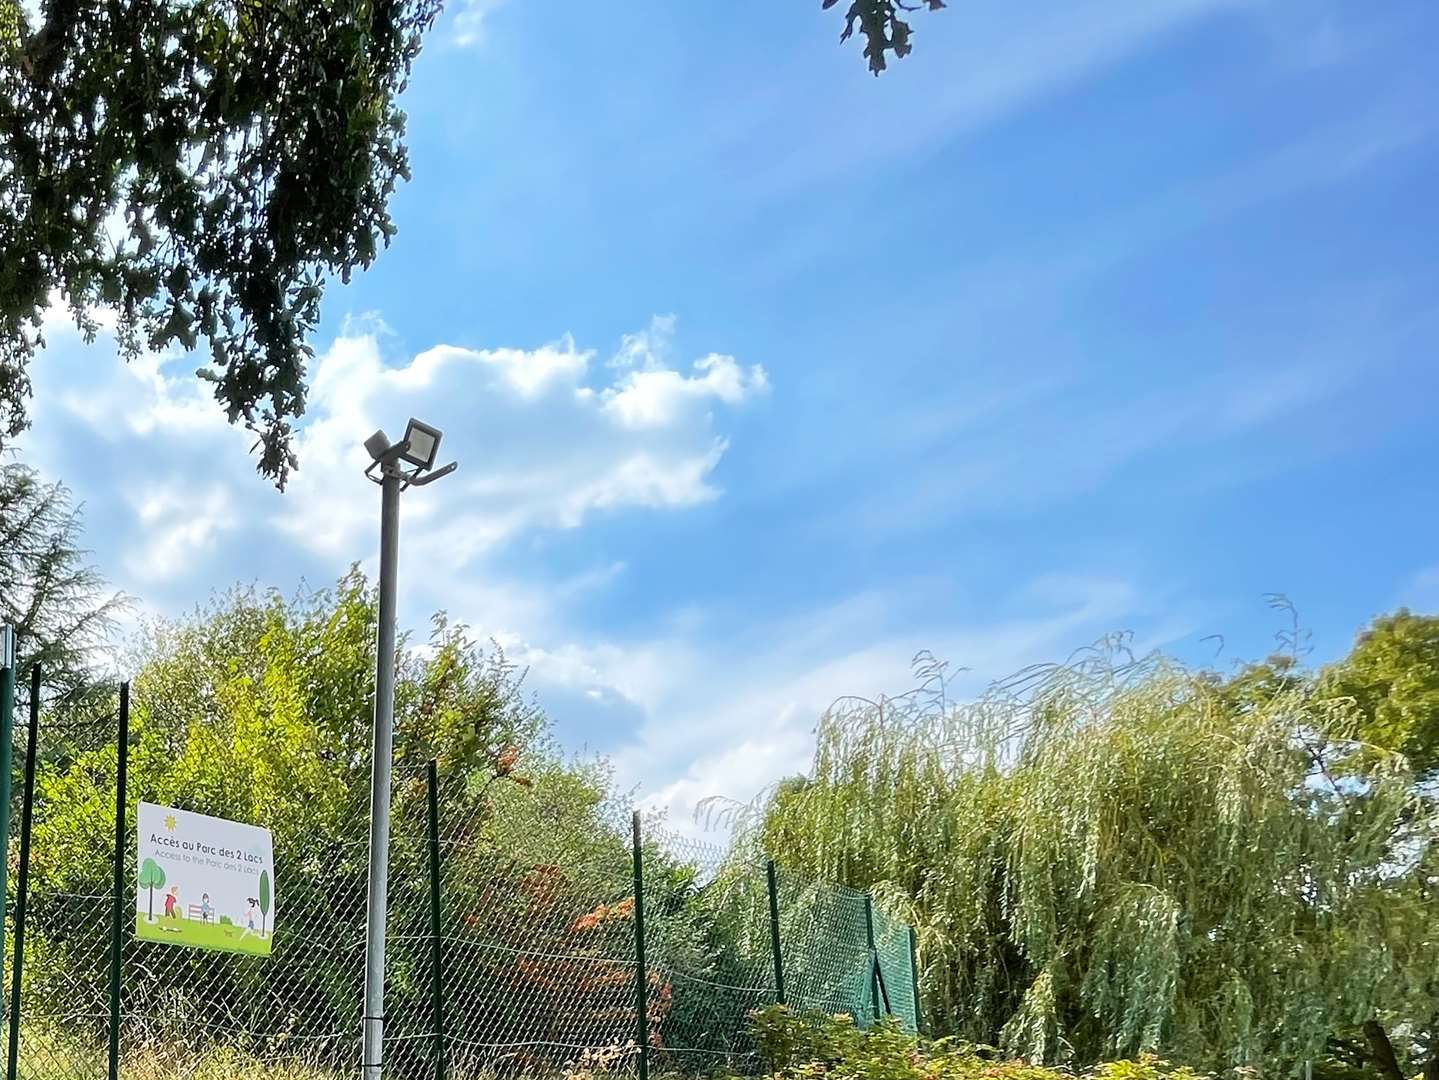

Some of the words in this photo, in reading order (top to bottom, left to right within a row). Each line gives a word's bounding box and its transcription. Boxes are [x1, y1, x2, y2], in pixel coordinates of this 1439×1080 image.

[150, 833, 179, 848] Accès
[182, 841, 194, 851] au
[196, 842, 216, 855] Parc
[218, 847, 234, 859] des
[236, 850, 242, 860] 2
[244, 851, 263, 864] Lacs
